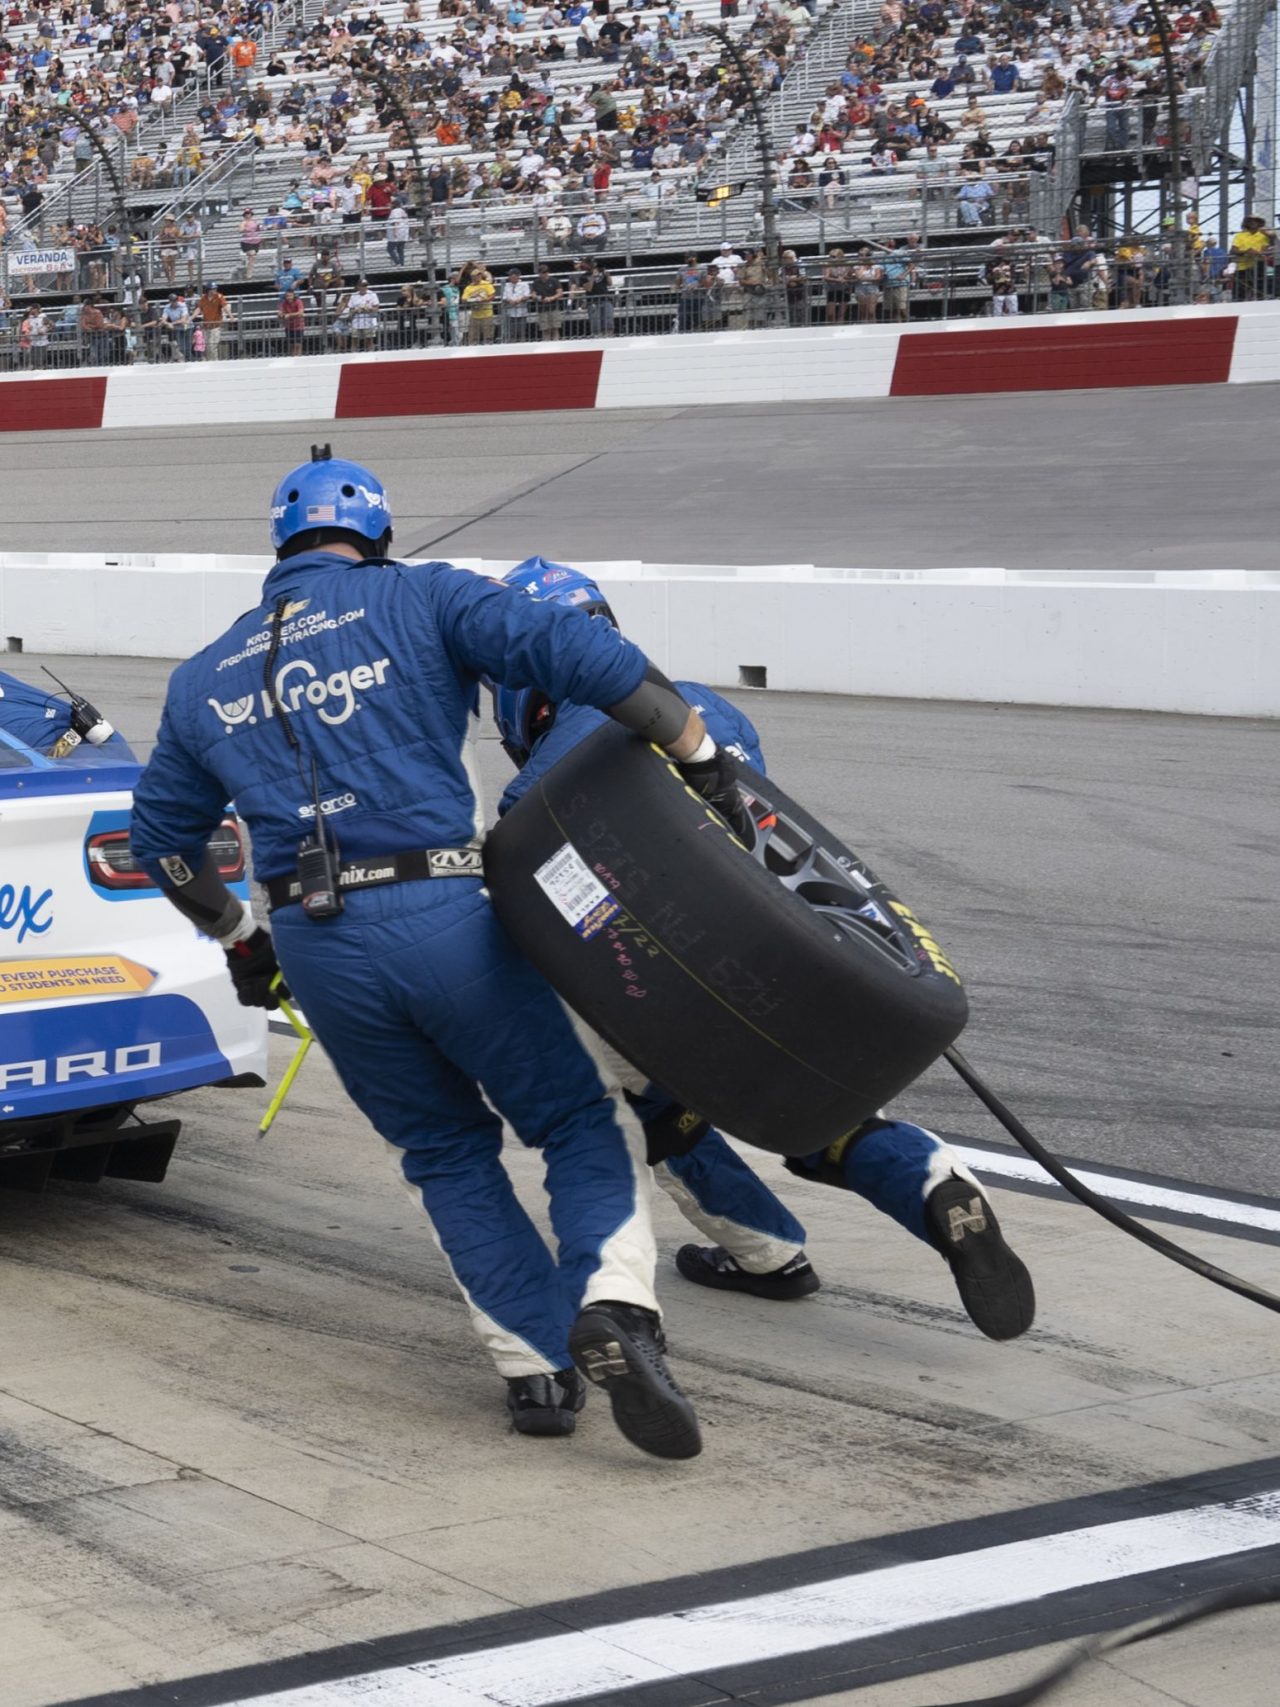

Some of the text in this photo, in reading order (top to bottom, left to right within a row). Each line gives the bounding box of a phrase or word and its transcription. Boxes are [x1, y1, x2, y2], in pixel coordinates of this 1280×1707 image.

[16, 251, 68, 265] VERANDA
[246, 610, 327, 647] KROER.COM
[1, 970, 44, 984] EVERY
[48, 966, 120, 979] PURCHASE
[8, 978, 77, 993] STUDENTS
[78, 977, 91, 987] IN
[93, 974, 127, 985] NEED
